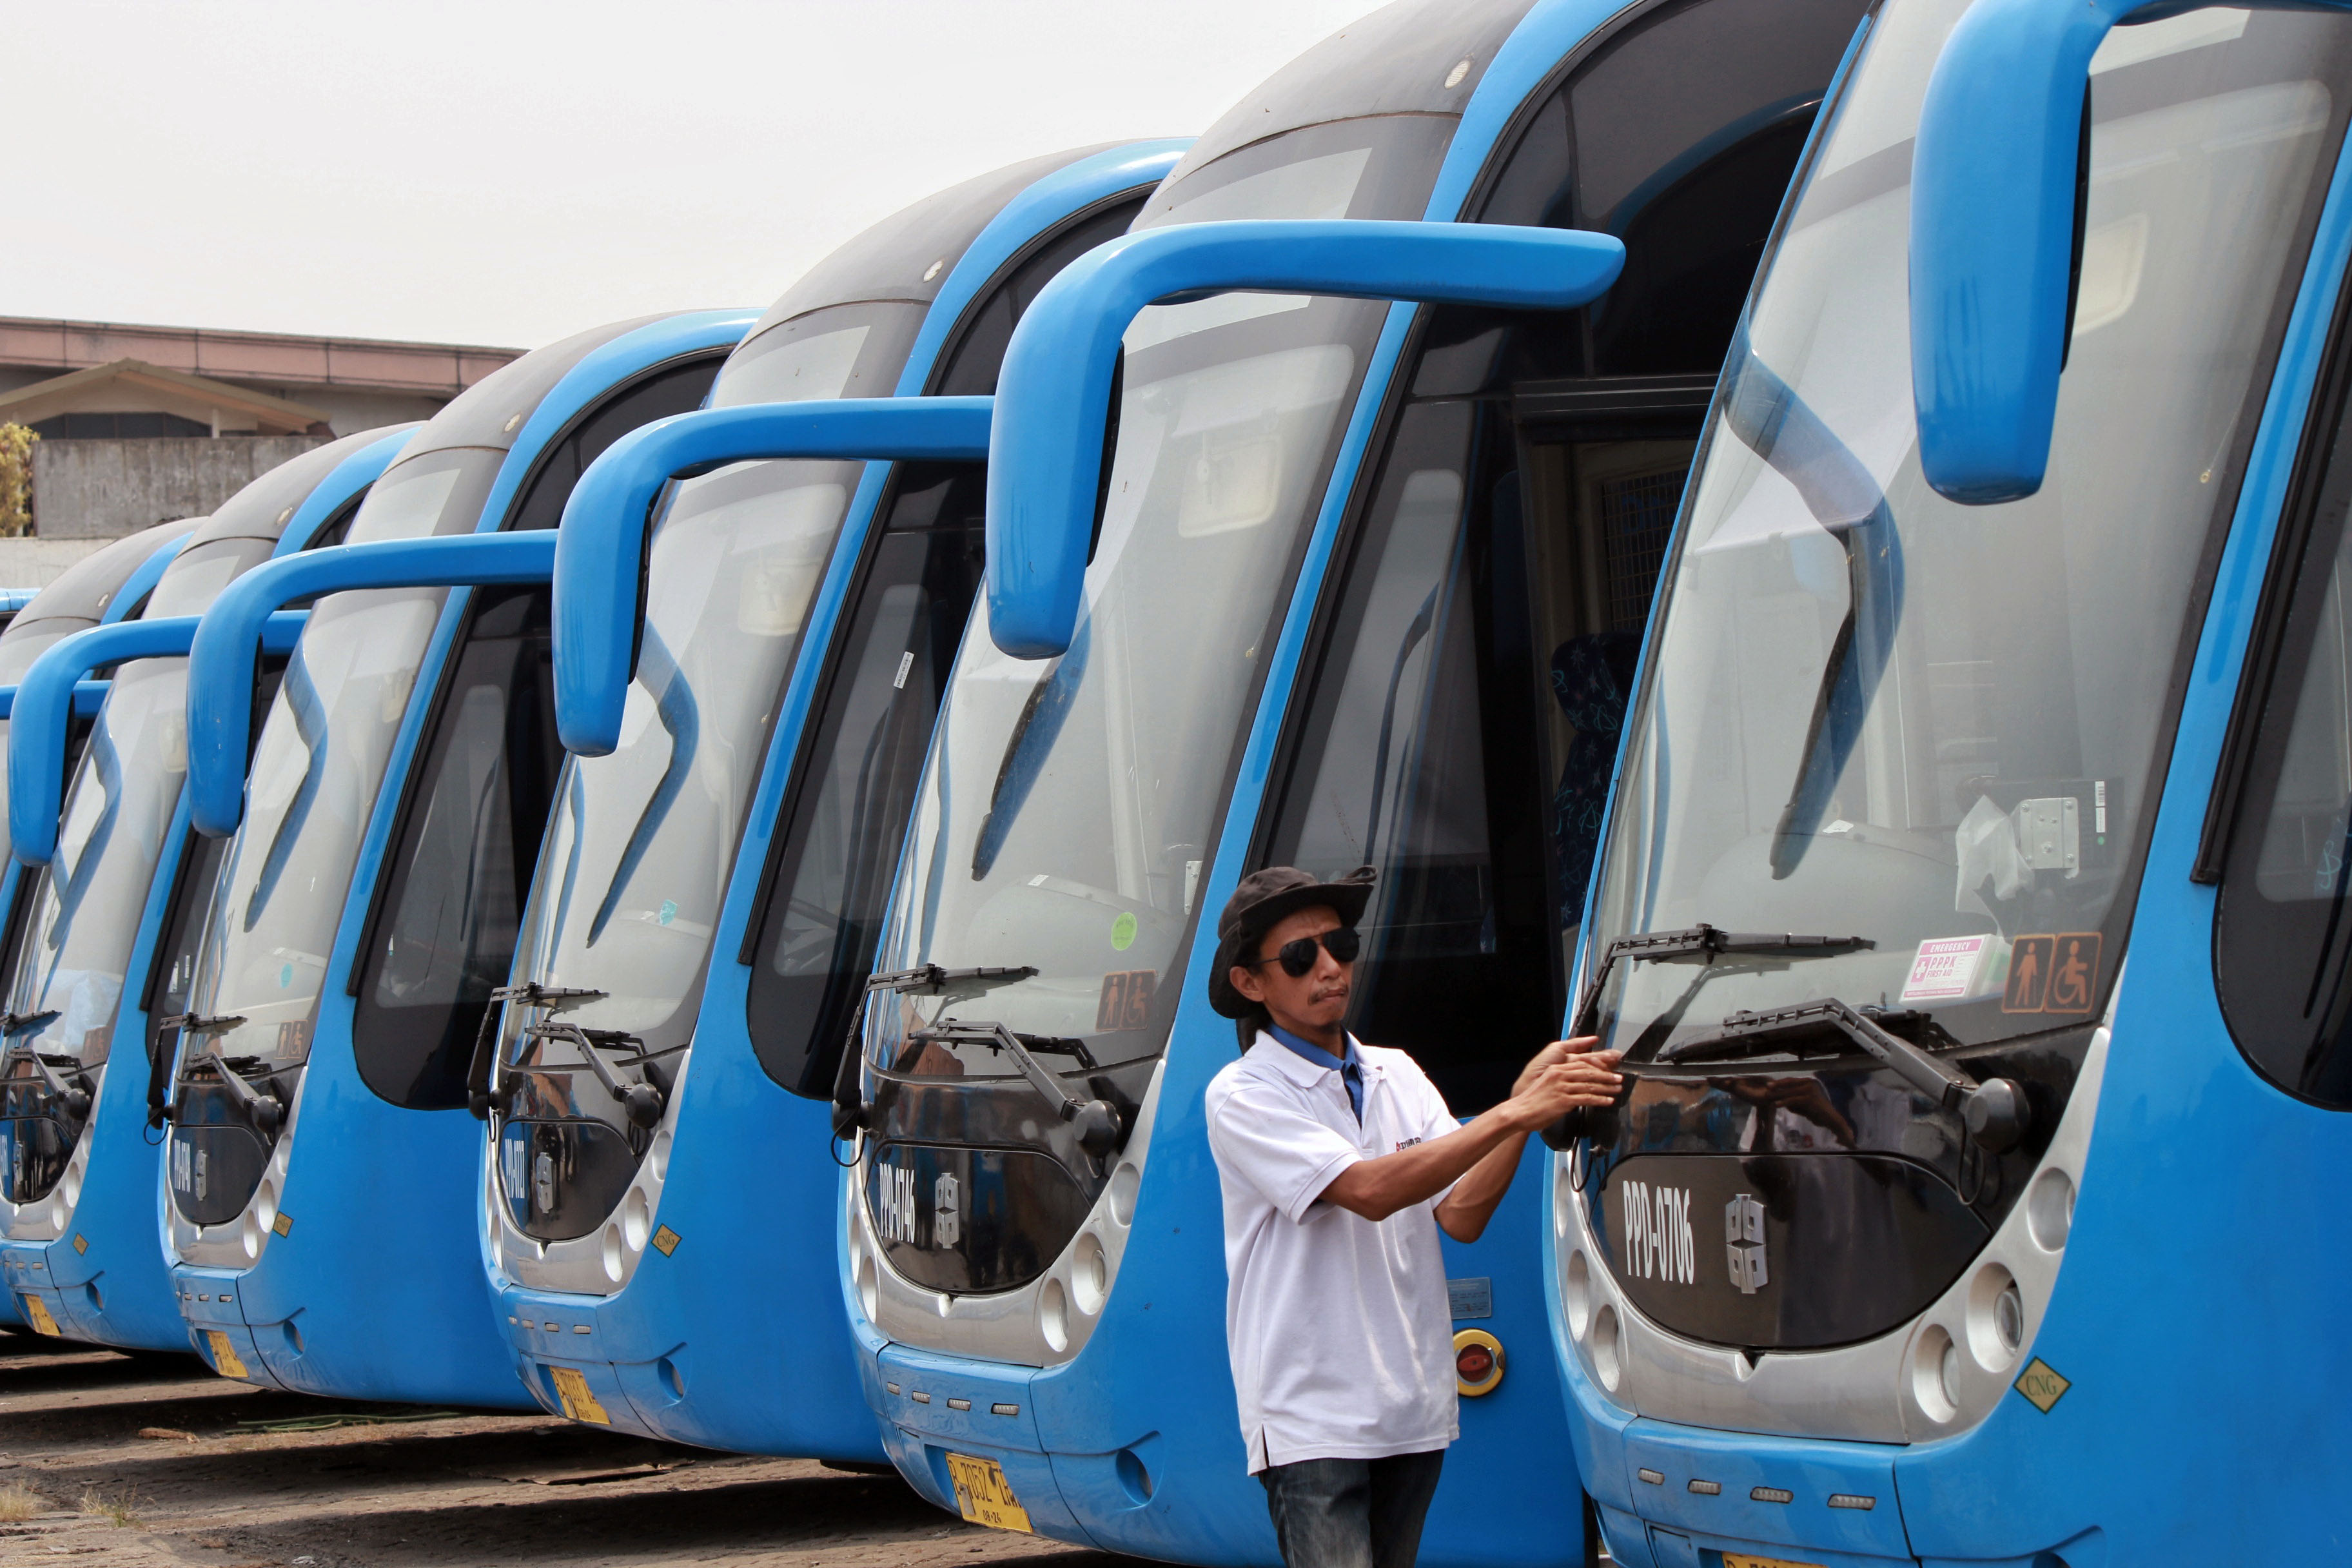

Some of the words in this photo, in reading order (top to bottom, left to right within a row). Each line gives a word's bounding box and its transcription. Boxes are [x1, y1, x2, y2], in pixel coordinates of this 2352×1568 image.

[1930, 942, 1971, 953] EMERGENCY
[1930, 956, 1957, 969] PPPK
[1926, 970, 1943, 978] FIRST
[1943, 968, 1953, 977] AID
[879, 1162, 915, 1244] PPD-0746
[657, 1233, 675, 1247] CNG
[1623, 1180, 1694, 1285] PPD-0706
[2026, 1374, 2057, 1396] CNG
[960, 1462, 993, 1502] 7052
